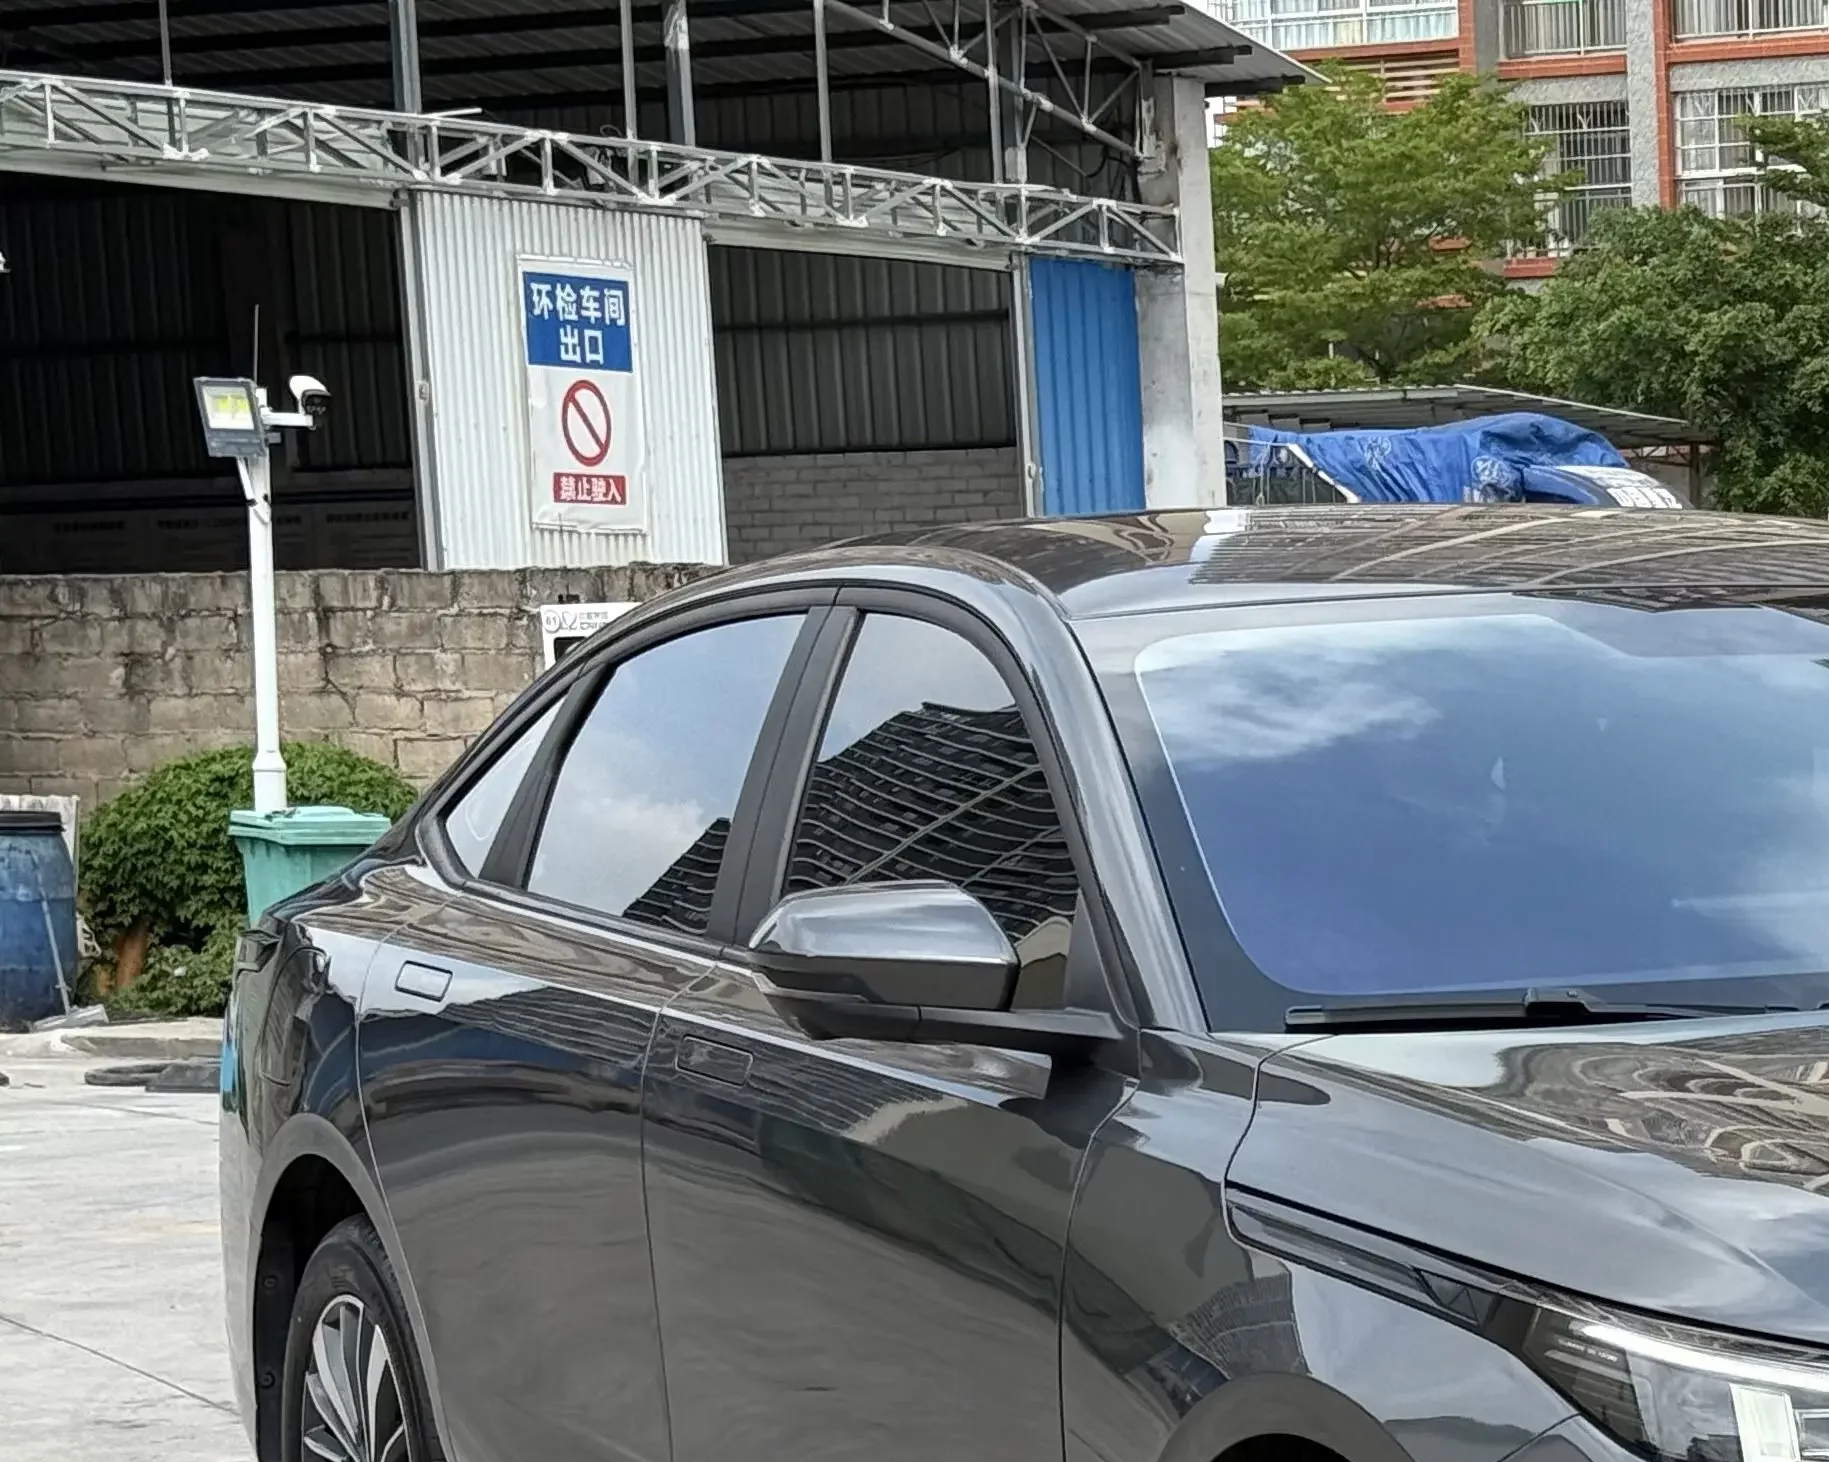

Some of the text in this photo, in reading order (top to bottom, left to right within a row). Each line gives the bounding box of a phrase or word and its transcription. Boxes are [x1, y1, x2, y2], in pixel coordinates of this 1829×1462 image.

[529, 281, 626, 326] 环检车间
[559, 324, 605, 365] 出口
[560, 475, 622, 503] 禁止驶入
